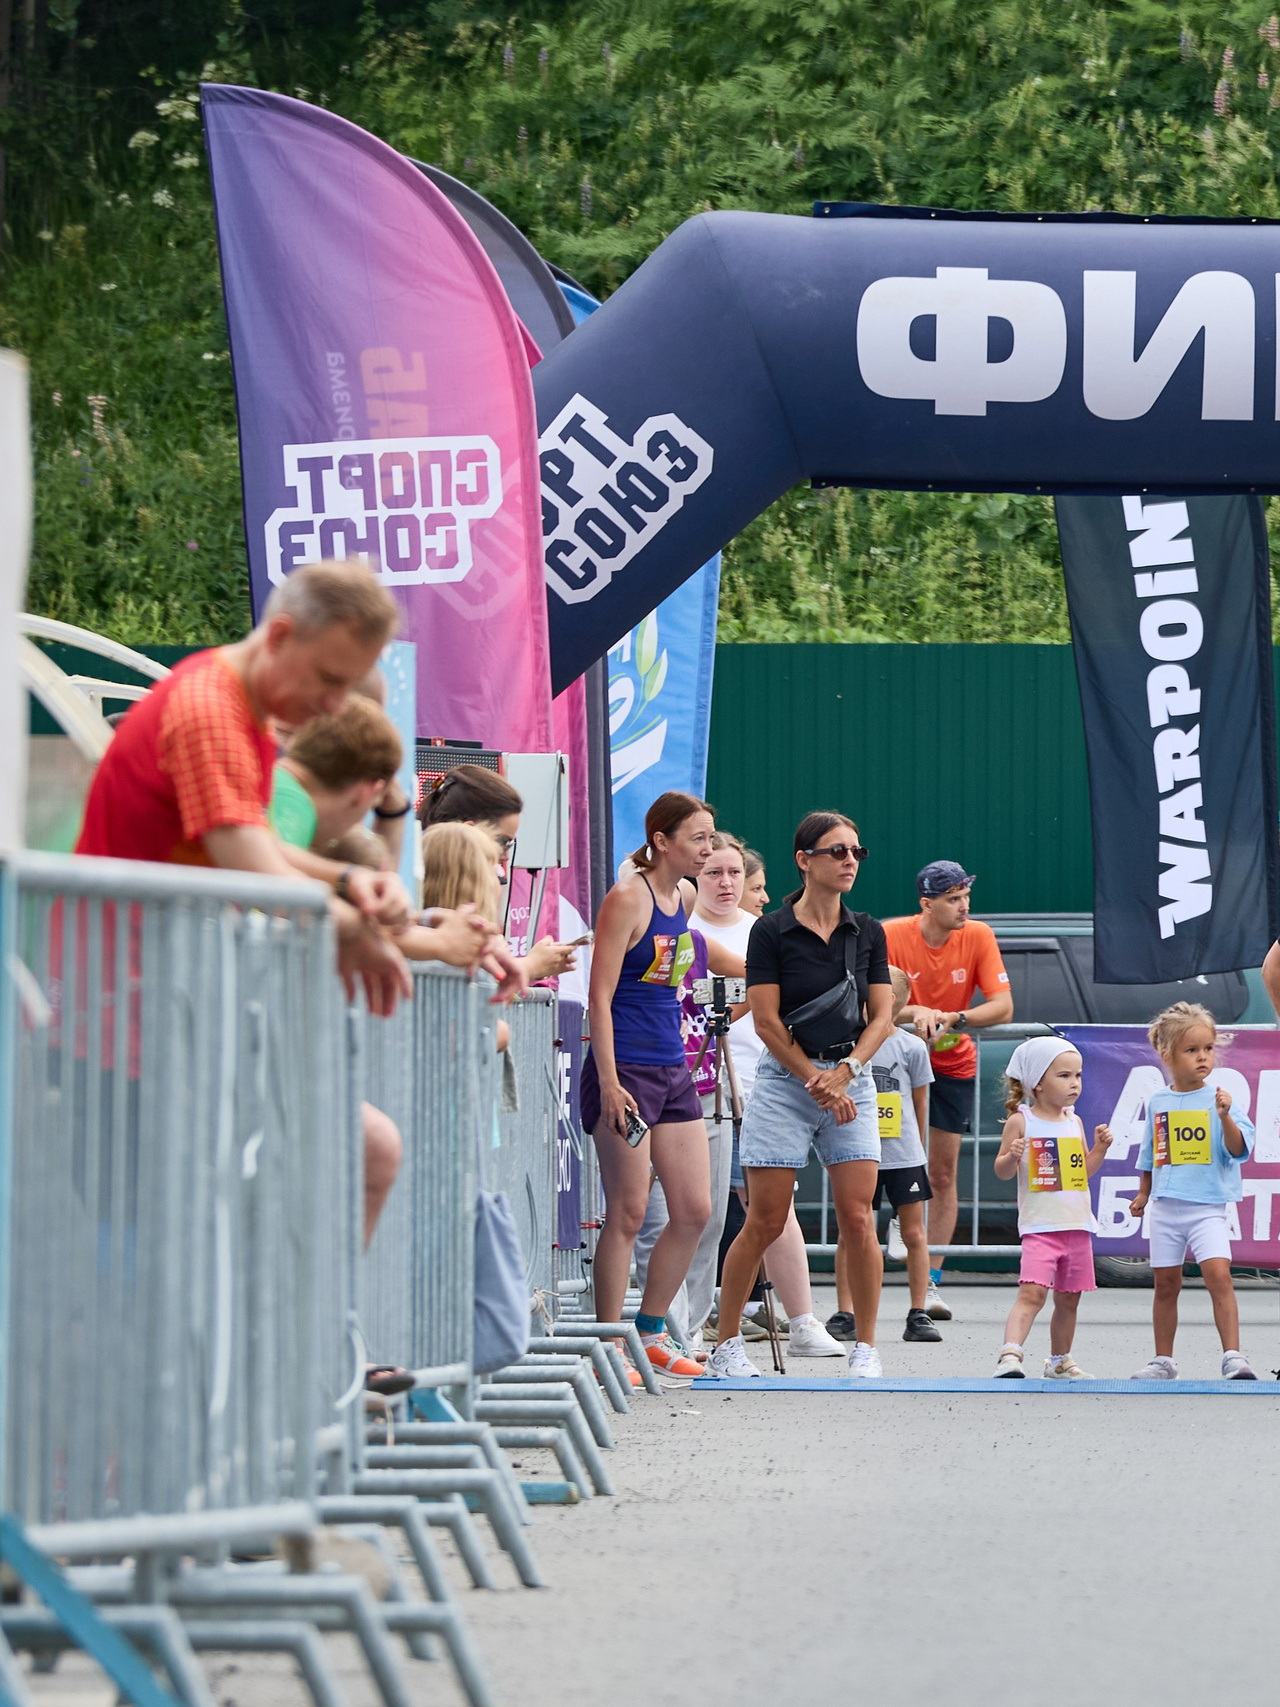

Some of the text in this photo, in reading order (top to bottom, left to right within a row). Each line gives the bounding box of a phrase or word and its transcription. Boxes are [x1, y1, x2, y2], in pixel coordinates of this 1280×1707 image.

[545, 429, 699, 591] СОЮЗ
[677, 947, 695, 966] 275
[1174, 1126, 1206, 1142] 100
